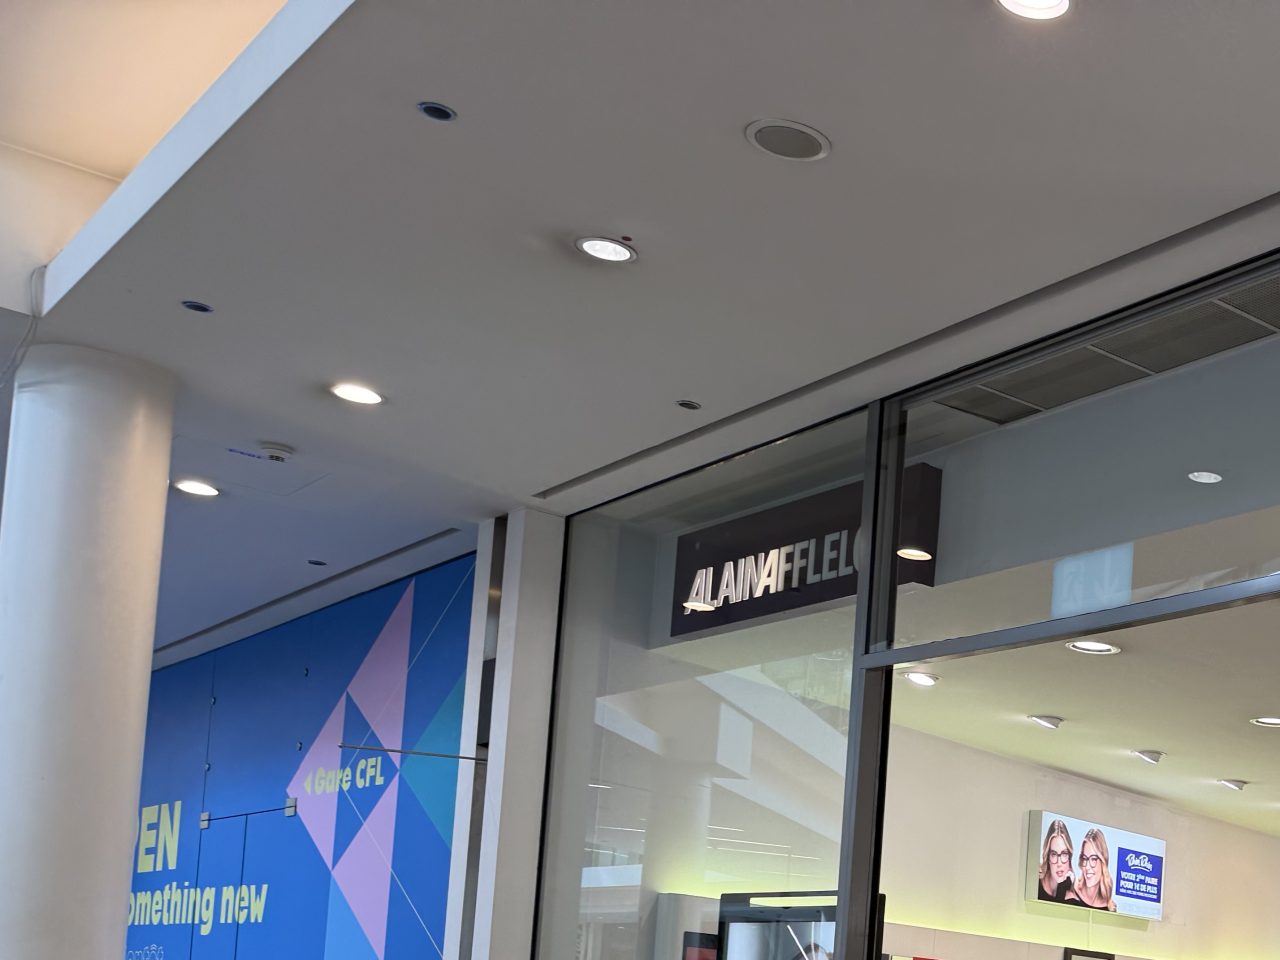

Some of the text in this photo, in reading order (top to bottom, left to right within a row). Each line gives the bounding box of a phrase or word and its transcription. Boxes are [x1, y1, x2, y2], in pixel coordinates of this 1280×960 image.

[683, 525, 864, 615] ALAINAFFLEL
[314, 756, 384, 796] Gare CFL
[135, 800, 182, 874] EN
[219, 883, 268, 924] new
